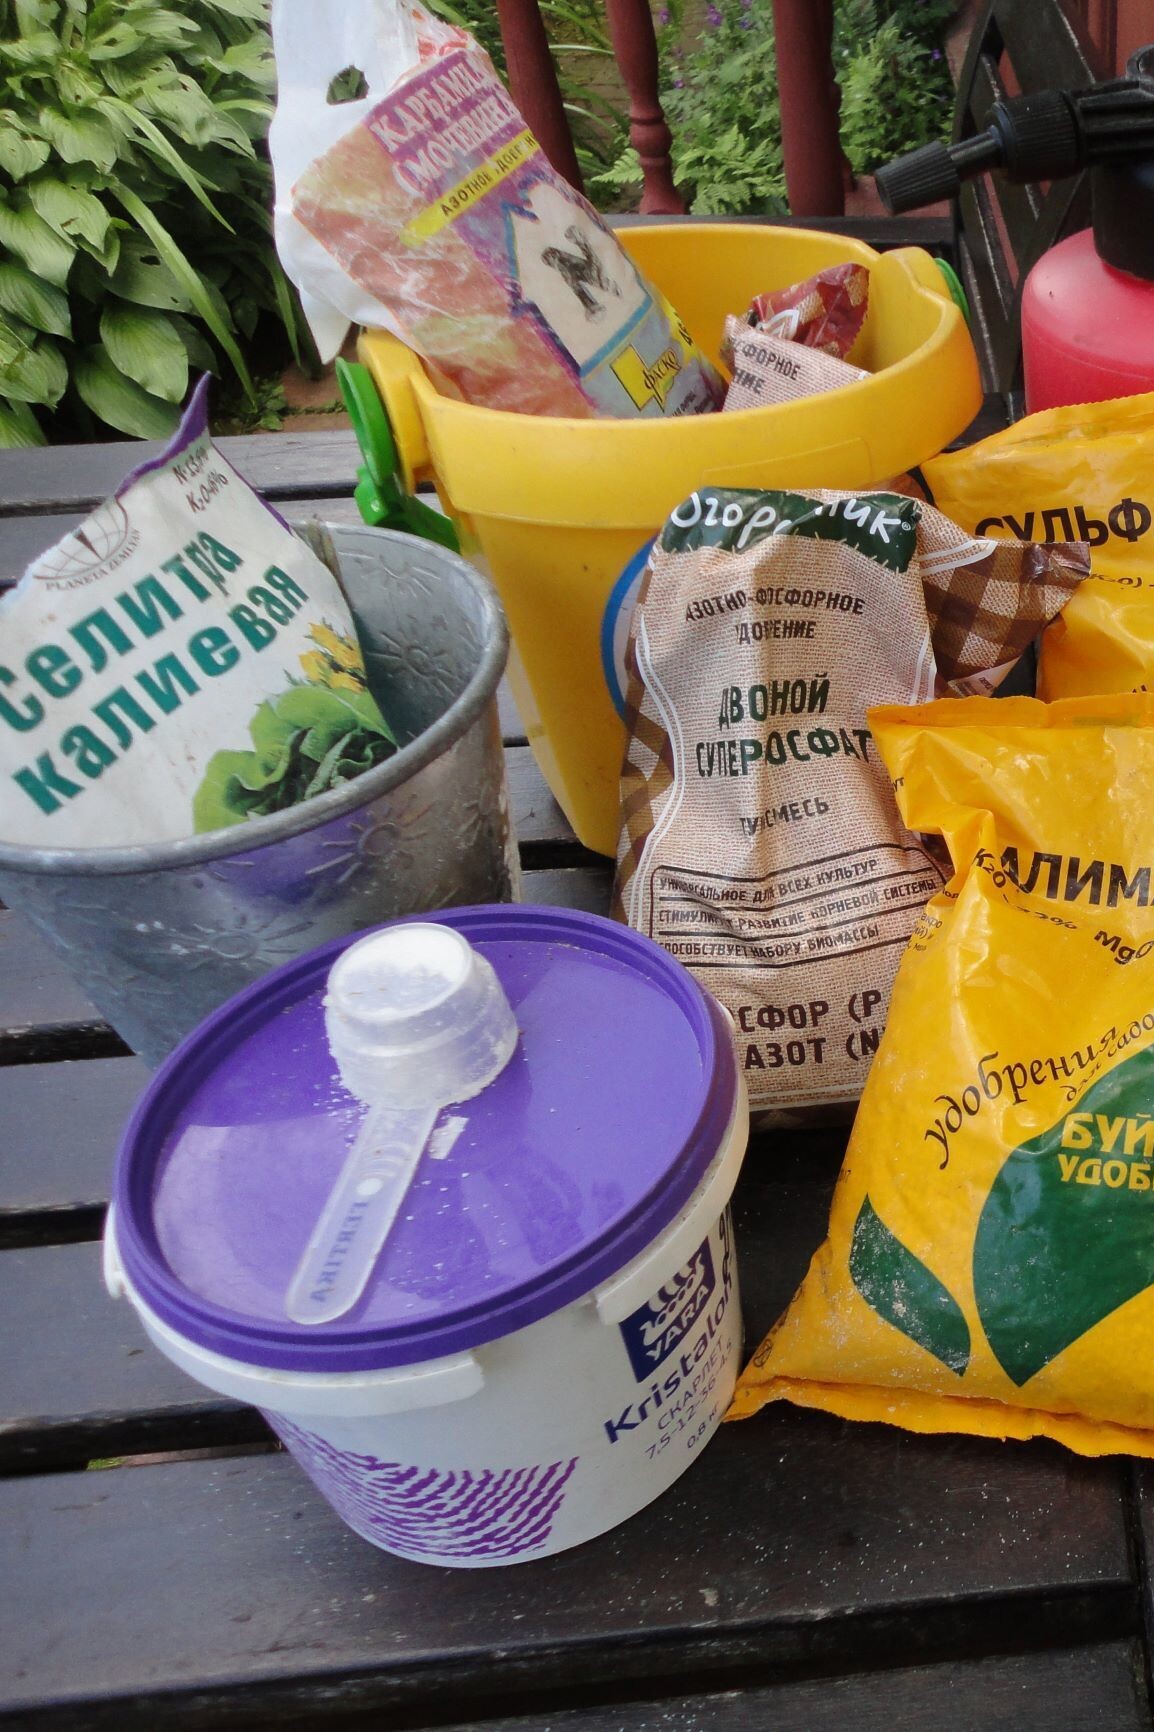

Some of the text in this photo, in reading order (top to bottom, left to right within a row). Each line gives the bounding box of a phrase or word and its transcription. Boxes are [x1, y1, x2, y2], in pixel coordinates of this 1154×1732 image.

[0, 530, 245, 733] Селитра
[11, 564, 310, 816] калиевая
[738, 911, 806, 931] РАЗВИТИЕ
[810, 888, 880, 920] КОРНЕВОЙ
[883, 878, 937, 901] СИСТЕМЫ
[778, 876, 813, 897] ВСЕХ
[816, 859, 878, 886] КУЛЬТУР
[750, 941, 805, 959] НАБОРУ
[807, 924, 880, 951] БИОМАССЫ
[728, 999, 830, 1033] СФОР
[744, 1037, 827, 1070] АЗОТ
[924, 1026, 1118, 1170] удобрения
[646, 1283, 710, 1362] YARA
[603, 1283, 733, 1445] Kristalon
